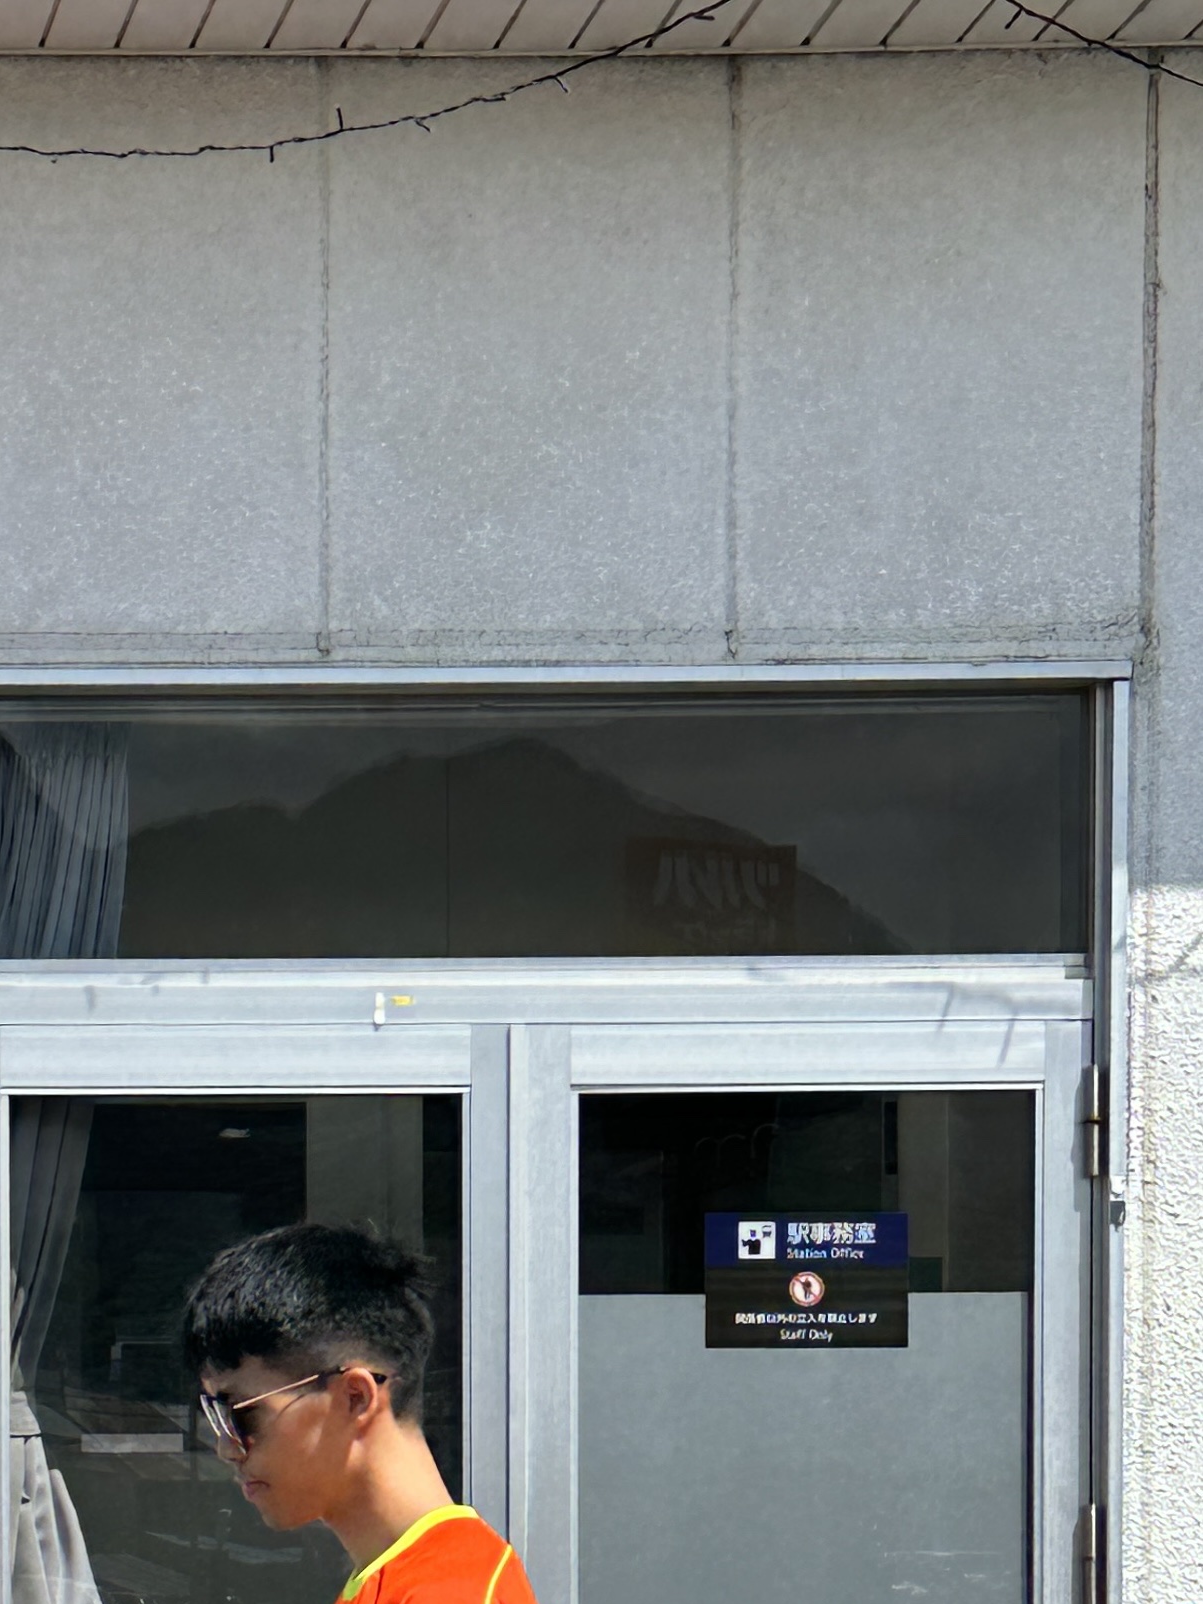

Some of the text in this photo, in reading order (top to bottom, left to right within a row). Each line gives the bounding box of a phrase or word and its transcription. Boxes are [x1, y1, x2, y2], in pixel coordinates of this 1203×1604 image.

[786, 1222, 877, 1245] 駅事務室
[786, 1248, 864, 1259] Station Office
[780, 1328, 834, 1342] Staff Only
